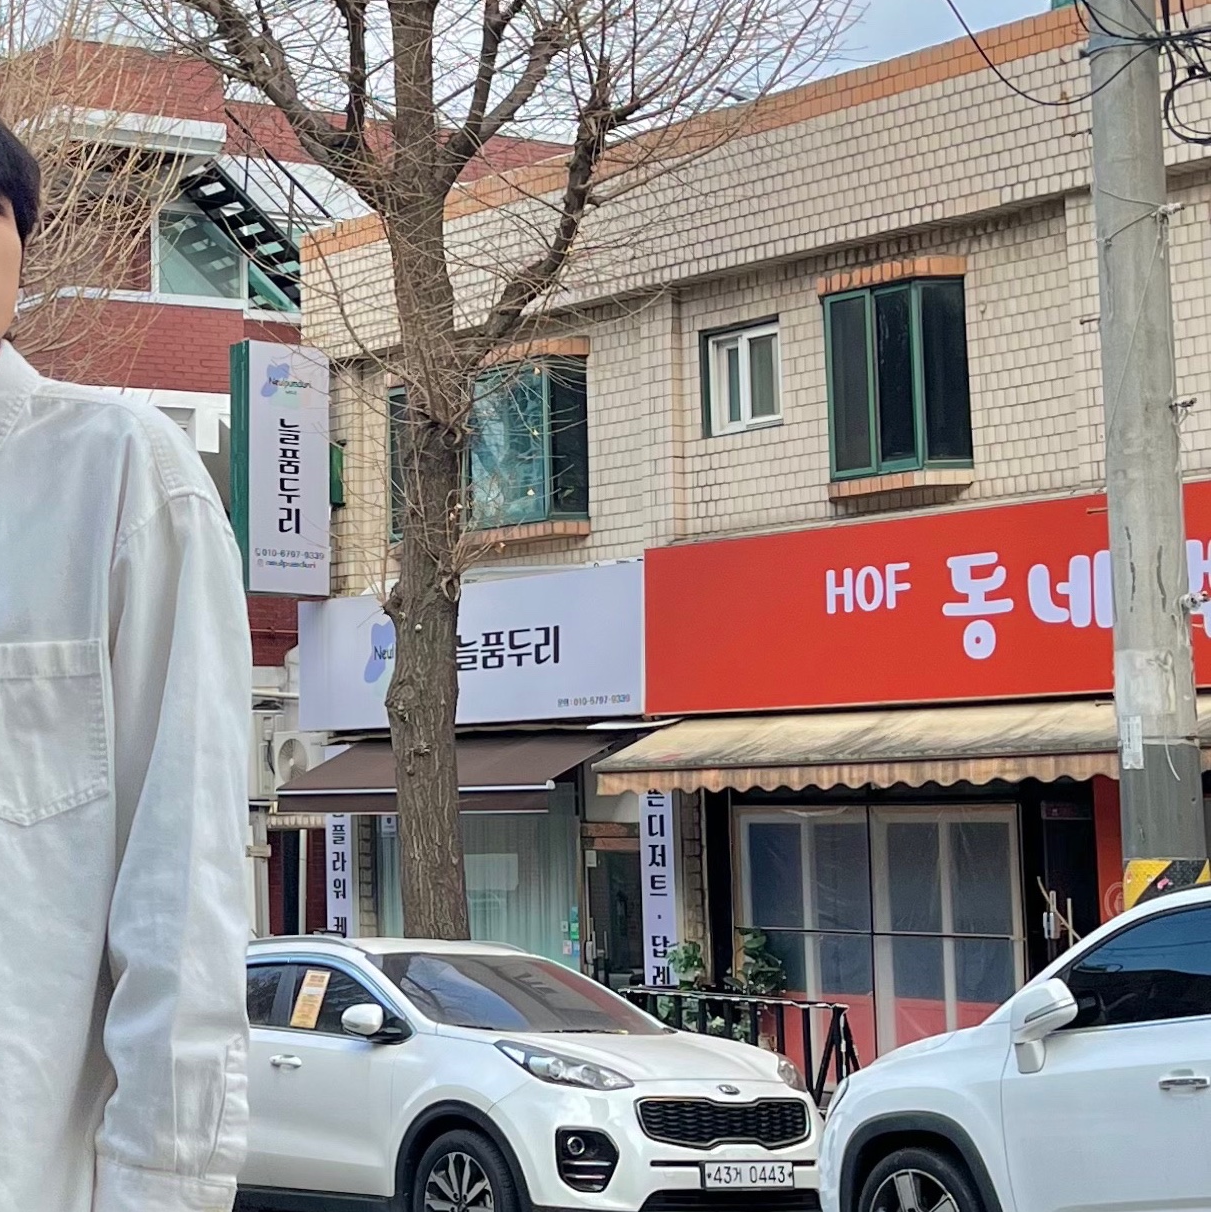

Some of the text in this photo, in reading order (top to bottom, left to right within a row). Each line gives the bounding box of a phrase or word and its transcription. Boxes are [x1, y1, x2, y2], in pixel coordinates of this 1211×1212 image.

[277, 418, 301, 535] 늘품두리
[456, 624, 560, 671] 늘품두리
[825, 562, 911, 614] HOF
[942, 550, 1113, 660] 동네
[331, 815, 347, 900] 플라워
[749, 1166, 786, 1183] 0443
